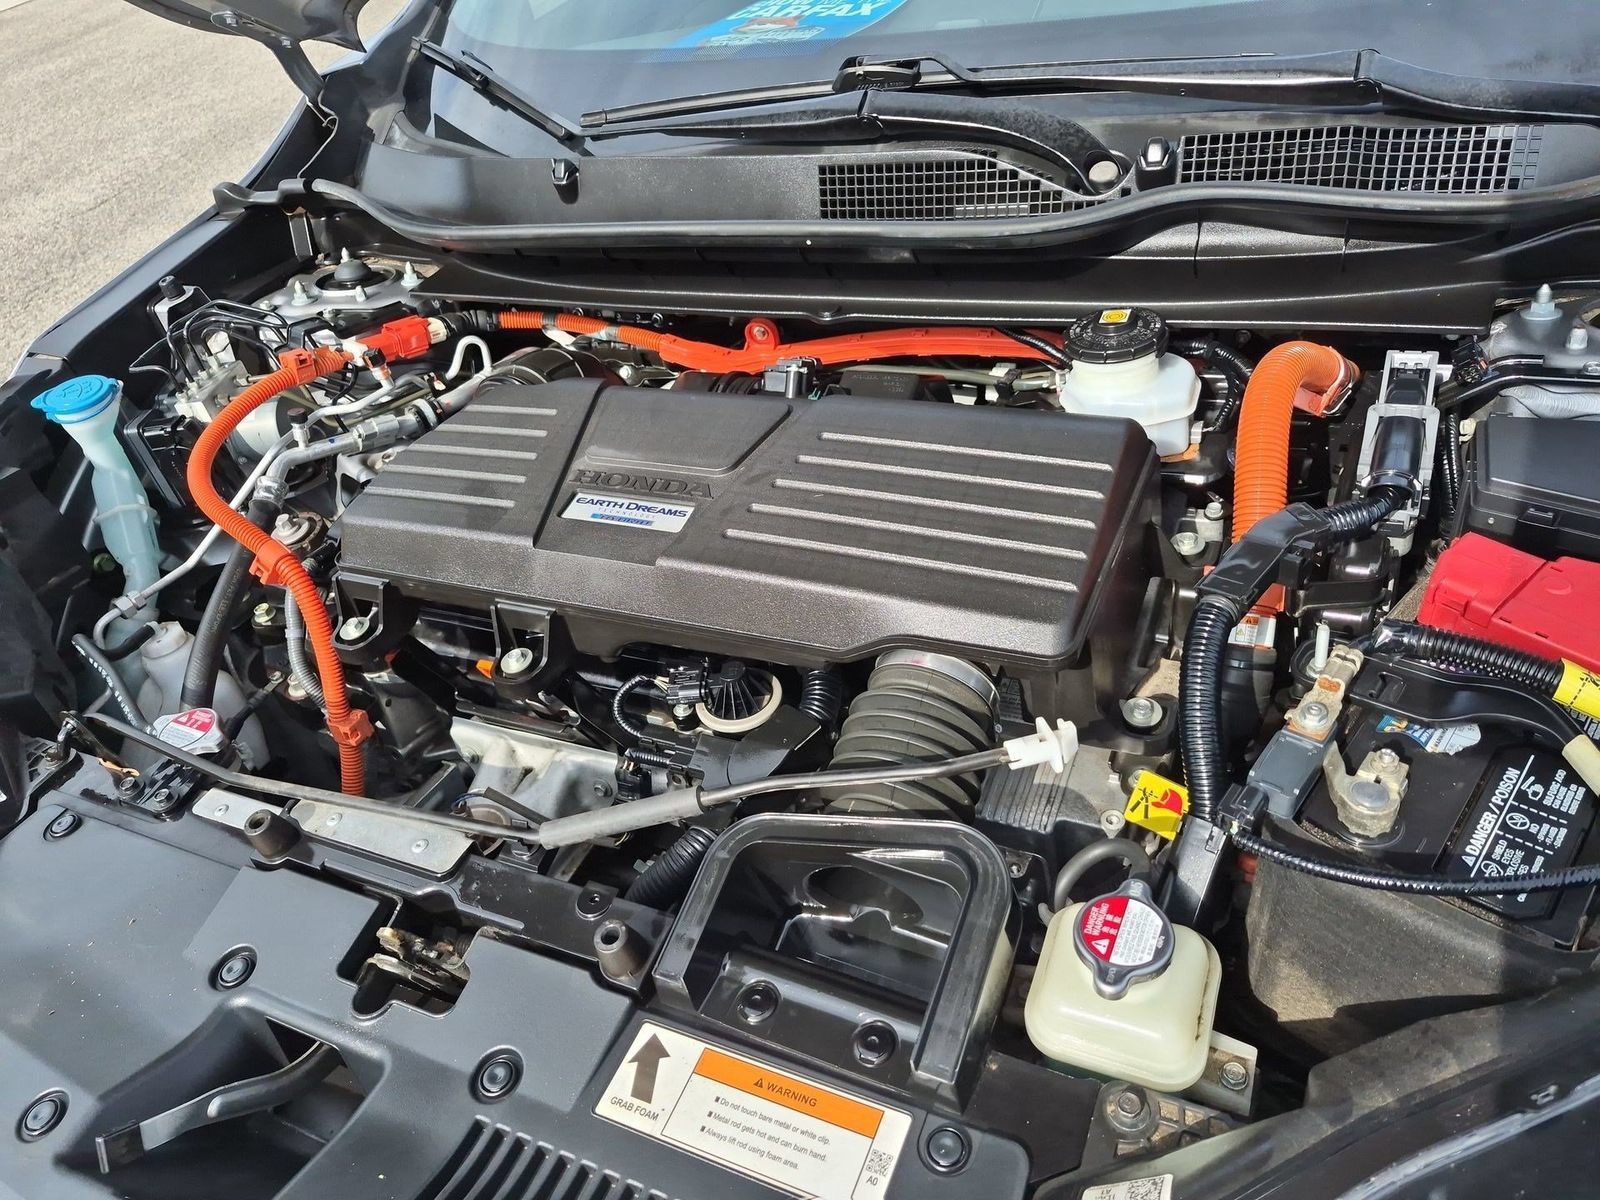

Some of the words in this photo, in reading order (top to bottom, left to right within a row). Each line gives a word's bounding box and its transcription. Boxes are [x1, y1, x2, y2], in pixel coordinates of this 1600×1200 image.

[726, 2, 886, 20] CARFAX
[569, 469, 714, 500] HONDA
[576, 497, 624, 509] EARTH
[626, 502, 688, 518] DREAMS
[1465, 811, 1498, 857] DANGER
[1491, 766, 1521, 806] POISON
[1529, 823, 1540, 834] NO
[1491, 839, 1508, 861] SHIELD
[1501, 849, 1515, 865] EYES
[1084, 906, 1100, 934] DANGER
[766, 1082, 818, 1107] WARNING
[610, 1096, 634, 1111] GRAB
[634, 1106, 660, 1121] FOAM
[720, 1098, 729, 1106] Do
[730, 1103, 741, 1111] not
[741, 1106, 758, 1118] touch
[758, 1112, 773, 1123] bare
[774, 1118, 792, 1130] metal
[800, 1129, 817, 1140] white
[705, 1128, 727, 1141] Always
[727, 1136, 737, 1145] lift
[736, 1140, 748, 1150] rod
[748, 1145, 766, 1158] using
[766, 1150, 783, 1163] foam
[712, 1112, 731, 1124] Metal
[730, 1120, 742, 1129] rod
[741, 1125, 756, 1135] gets
[756, 1129, 767, 1139] hot
[767, 1134, 780, 1144] and
[780, 1139, 792, 1148] can
[793, 1144, 809, 1155] burn
